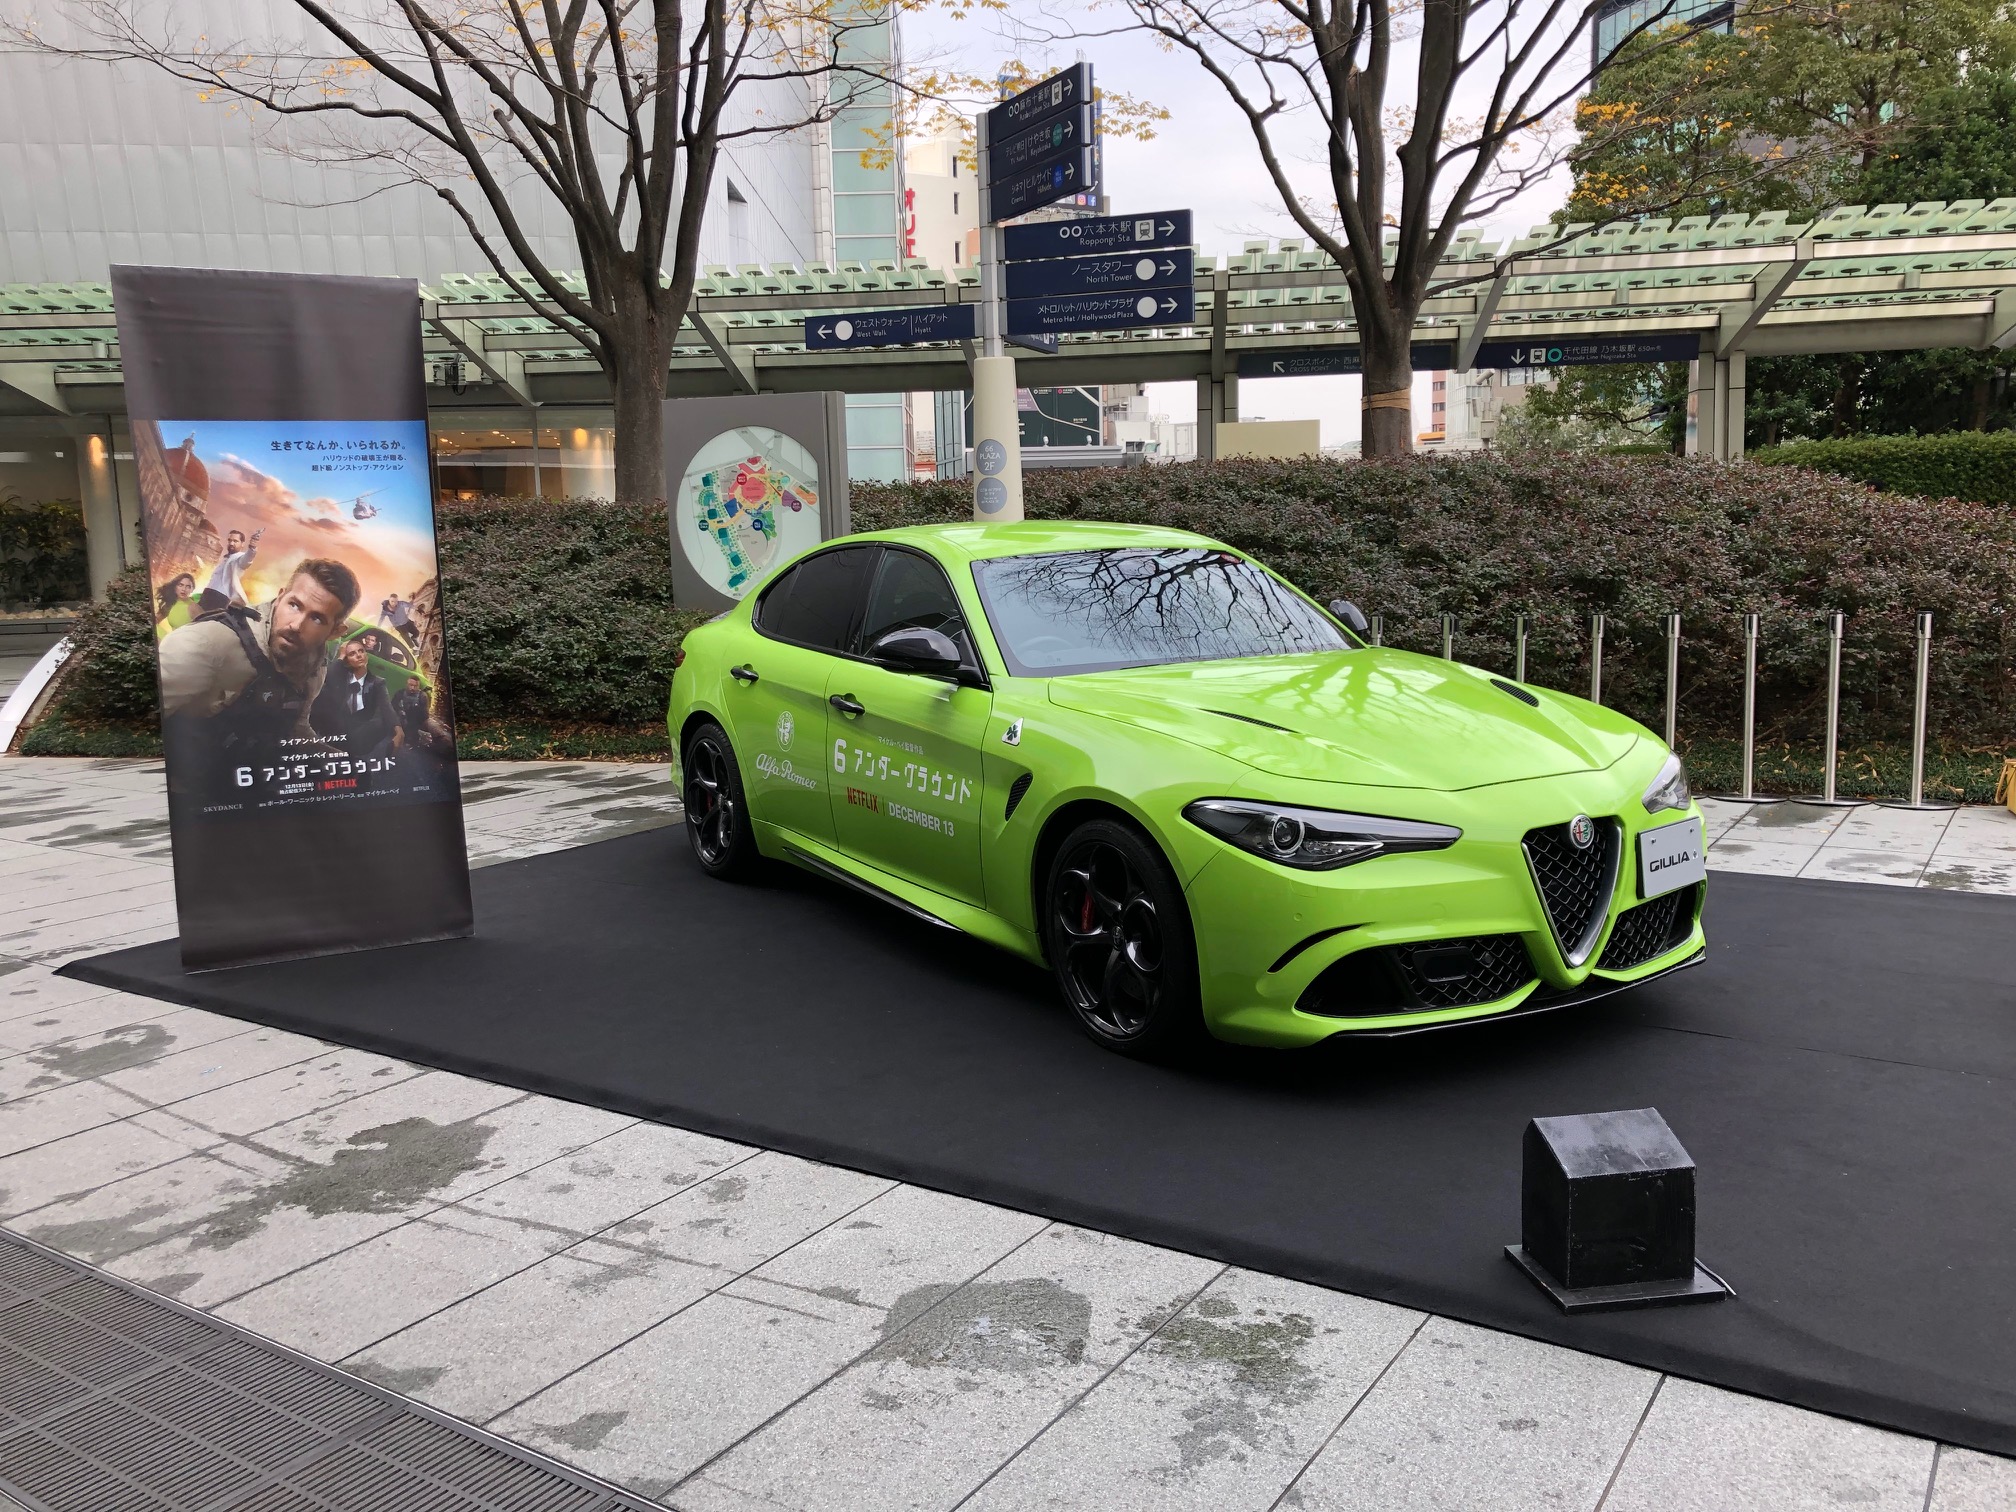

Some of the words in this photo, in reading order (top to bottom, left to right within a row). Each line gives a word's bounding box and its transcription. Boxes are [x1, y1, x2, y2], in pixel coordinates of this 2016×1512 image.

[1028, 127, 1050, 147] けやき坂
[1026, 168, 1051, 189] ヒルサイド
[1011, 181, 1023, 194] シネマ
[1084, 220, 1131, 236] 六本木駅
[1080, 237, 1116, 246] Roppongi
[1072, 260, 1133, 275] ノースタワー
[1087, 275, 1109, 284] North
[1110, 273, 1133, 282] Tower
[1038, 297, 1134, 315] メトロハット/ハリウッドプラザ
[855, 316, 908, 328] ウェストウォーク
[915, 313, 948, 324] ハイアット
[1081, 312, 1116, 321] Hollywood
[915, 327, 931, 335] Hyatt
[1564, 346, 1598, 355] 千代田線
[1601, 344, 1636, 354] 乃木坂駅
[1290, 357, 1340, 367] クロスポイント
[271, 440, 406, 451] 生きてなんか、いられるか。
[980, 452, 1001, 460] PLAZA
[984, 461, 996, 471] 2F
[280, 734, 348, 747] ライアン・レイノルズ
[236, 766, 254, 787] 6
[262, 756, 397, 782] アンダーグラウンド
[756, 753, 781, 780] Alfa
[780, 760, 818, 790] Romeo
[834, 738, 847, 774] 6
[854, 748, 973, 804] アンダーグラウンド
[324, 778, 358, 790] NETFLIX
[203, 803, 244, 813] SKYDANCE
[846, 786, 879, 814] NETFLIX
[888, 802, 942, 833] DECEMBER
[943, 821, 955, 837] 13
[1649, 851, 1691, 873] GIULIA
